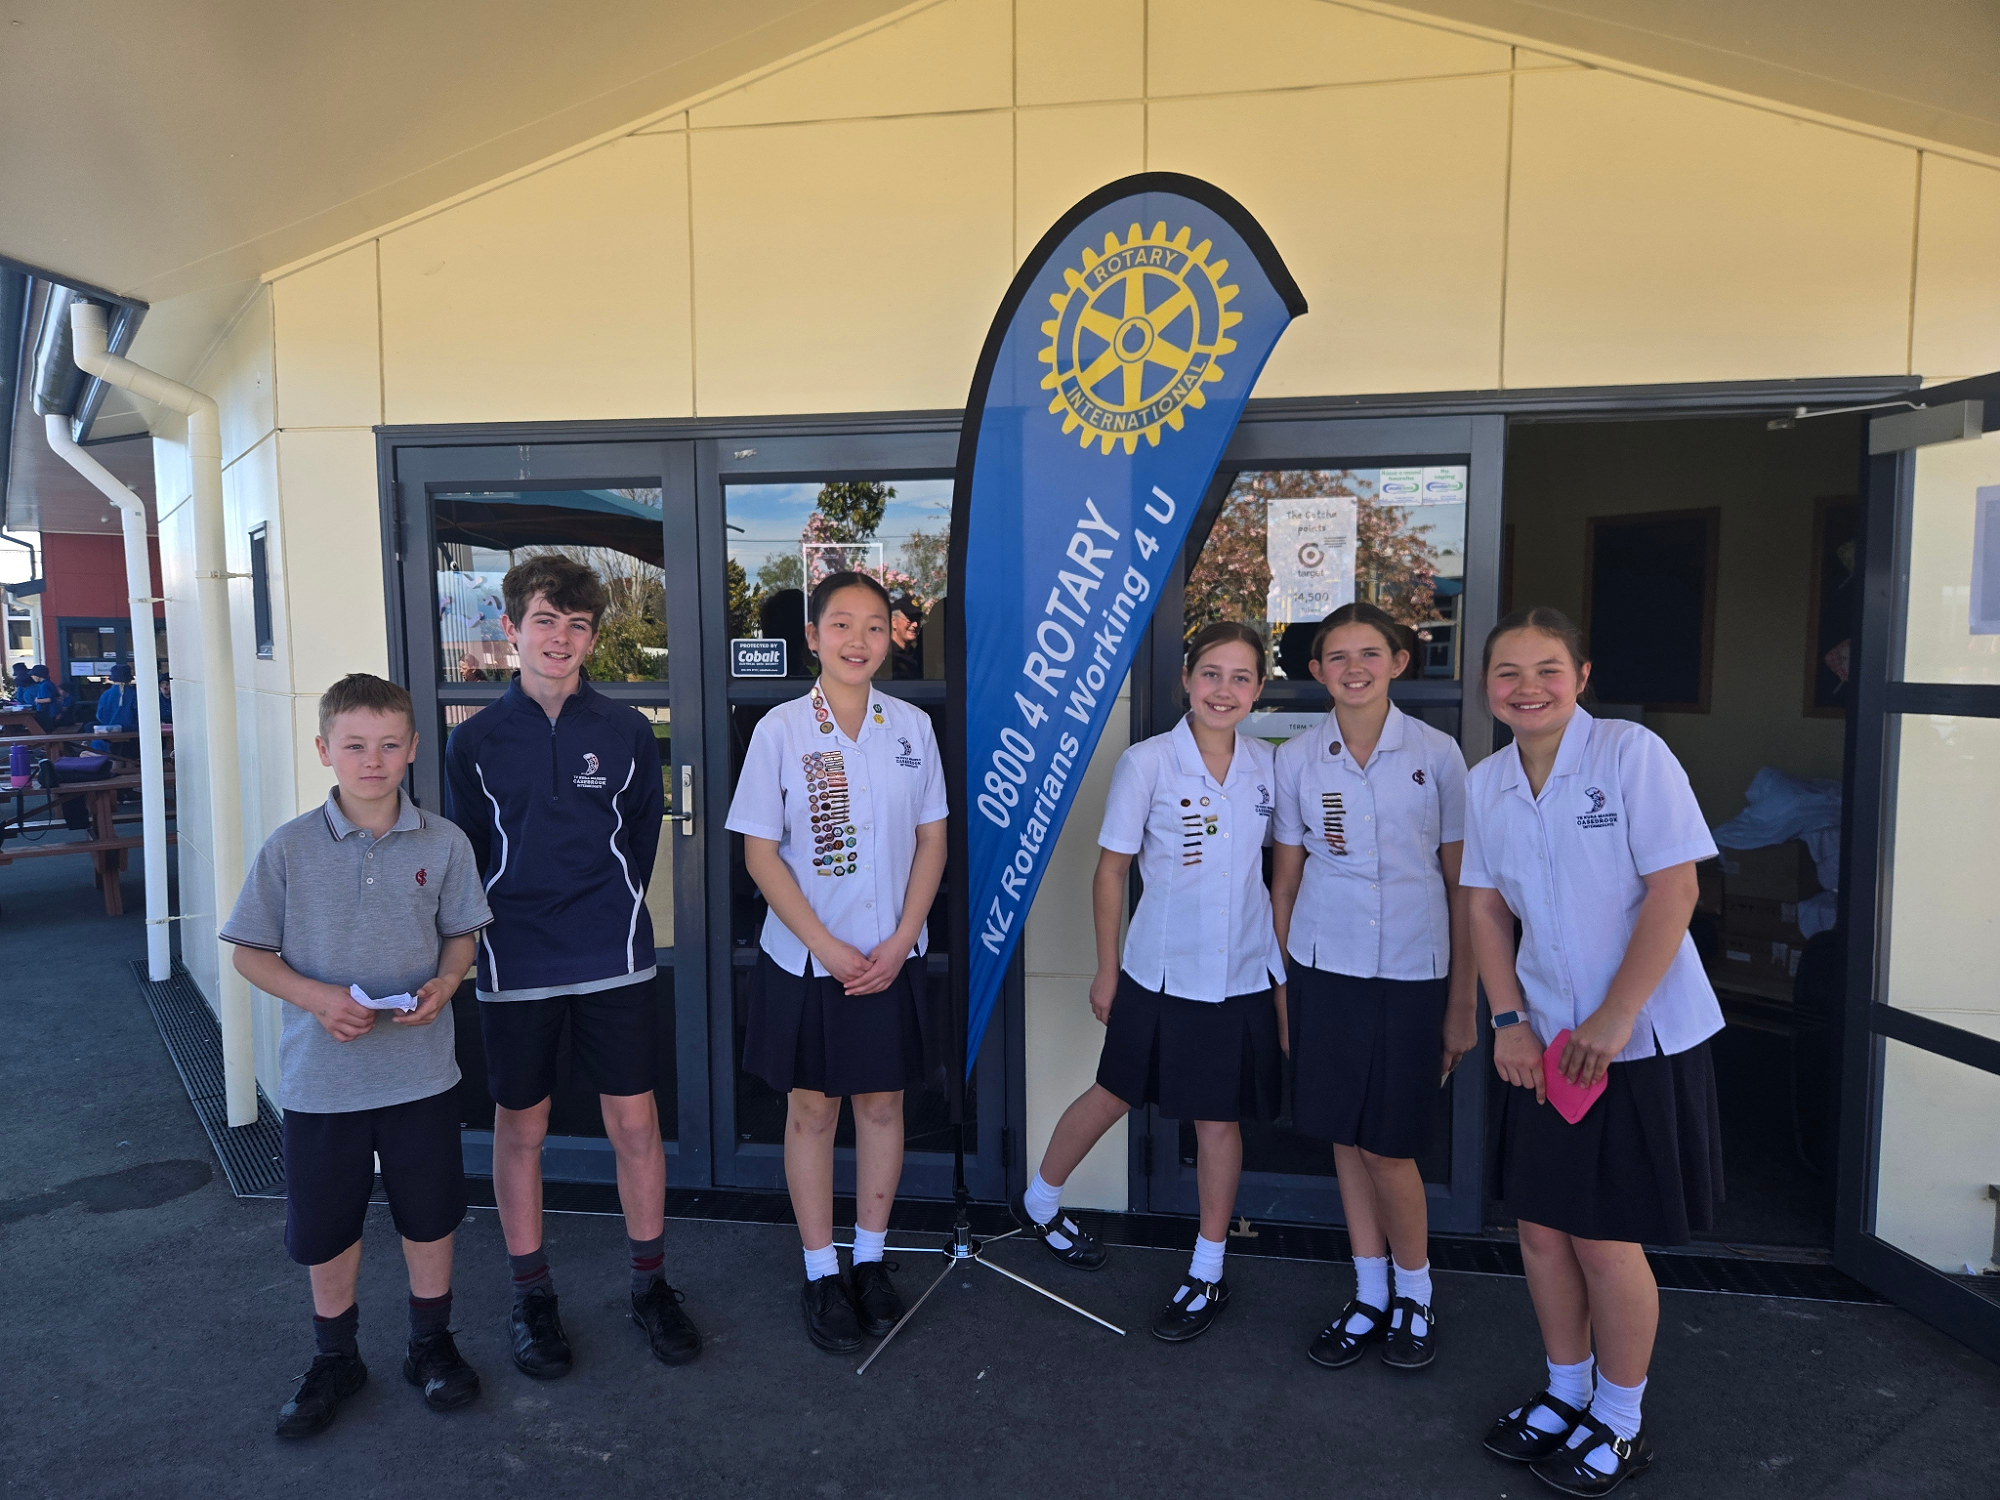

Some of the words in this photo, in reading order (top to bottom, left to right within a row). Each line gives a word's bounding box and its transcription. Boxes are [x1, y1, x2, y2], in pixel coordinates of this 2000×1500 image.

[1096, 248, 1178, 283] ROTARY
[1066, 360, 1207, 431] INTERNATIONAL
[1144, 485, 1176, 525] U
[1286, 510, 1302, 519] The
[1134, 528, 1160, 561] 4
[1297, 525, 1326, 536] points
[1297, 569, 1324, 578] target
[1023, 497, 1120, 698] ROTARY
[738, 650, 780, 662] Cobalt
[1064, 565, 1150, 725] Working
[1014, 691, 1049, 729] 4
[977, 727, 1036, 828] 0800
[1001, 731, 1079, 901] Rotarians
[981, 895, 1014, 955] NZ
